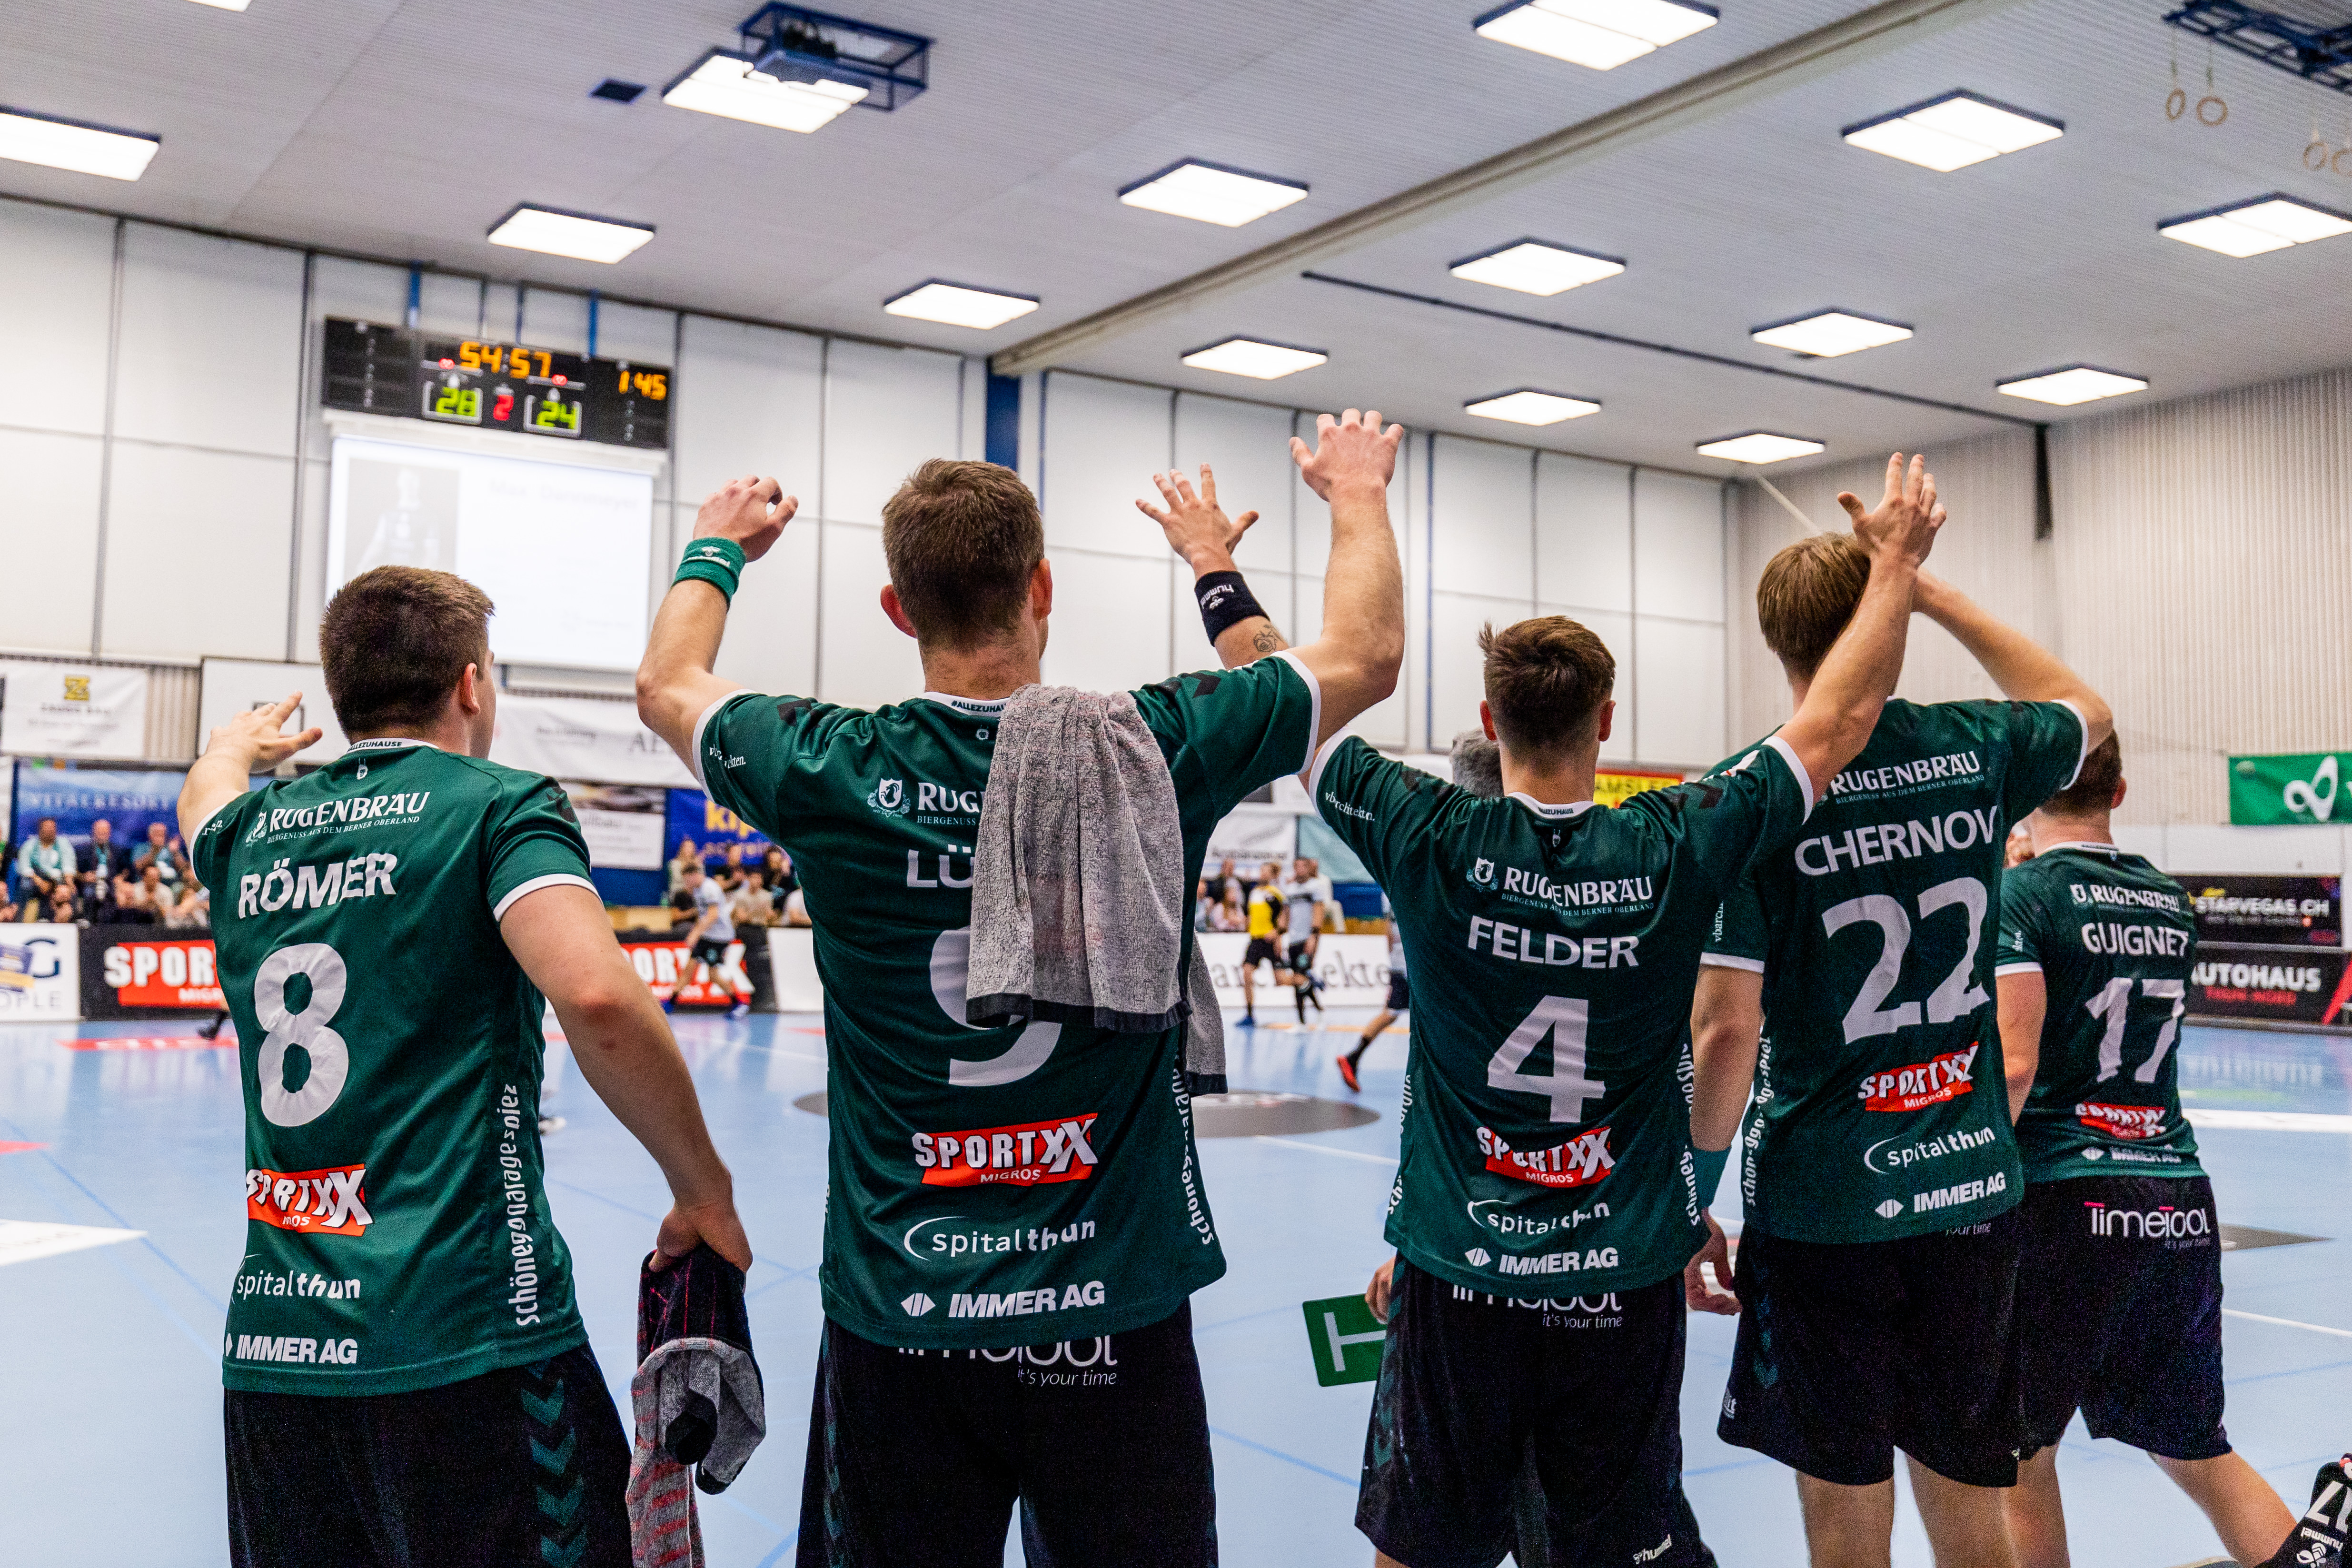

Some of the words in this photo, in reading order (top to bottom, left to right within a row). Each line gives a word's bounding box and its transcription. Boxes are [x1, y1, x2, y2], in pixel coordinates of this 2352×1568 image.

[436, 387, 477, 417] 28
[493, 394, 515, 421] 2
[536, 400, 577, 430] 24
[951, 700, 1006, 713] #ALLEZUHAU
[1830, 750, 1980, 795] RUGENBRÄU
[269, 792, 430, 833] RUGENBRÄU
[917, 782, 985, 813] RUG
[267, 831, 307, 844] BIERGENUSS
[308, 827, 321, 836] AUS
[322, 826, 342, 834] DEM
[343, 821, 371, 833] BERNER
[374, 816, 420, 827] OBERLAND
[917, 815, 976, 826] BIERGENUSS
[1794, 805, 1998, 876] CHERNOV
[238, 853, 397, 919] RÖMER
[1504, 866, 1653, 907] RUGENBRÄU
[1501, 893, 1548, 910] BIERGENUSS
[1563, 909, 1579, 917] DEM
[1581, 907, 1612, 915] BERNER
[1614, 902, 1654, 913] OBERLAND
[1467, 915, 1640, 970] FELDER
[2081, 922, 2189, 956] GUIGNET
[104, 946, 215, 988] SPOR
[1821, 876, 1990, 1044] 22
[2191, 962, 2322, 992] AUTOHAUS
[254, 943, 349, 1127] 8
[2085, 977, 2185, 1083] 17
[1488, 994, 1607, 1123] 4
[1904, 1087, 1952, 1108] MIGROS
[911, 1118, 1099, 1173] SPORTXX
[980, 1167, 1042, 1183] MIGROS
[1525, 1171, 1574, 1183] MIGROS
[1914, 1180, 1985, 1213] IMMER
[1986, 1171, 2006, 1195] AG
[1499, 1251, 1581, 1276] IMMER
[1582, 1247, 1619, 1270] AG
[948, 1288, 1057, 1318] IMMER
[1059, 1280, 1105, 1310] AG
[1542, 1313, 1560, 1327] it's
[1564, 1316, 1592, 1329] your
[1595, 1314, 1623, 1328] time
[236, 1334, 318, 1362] IMMER
[318, 1338, 358, 1364] AG
[1017, 1364, 1035, 1384] it's
[1040, 1370, 1079, 1387] your
[1083, 1369, 1117, 1385] time
[2301, 1527, 2343, 1552] hummel
